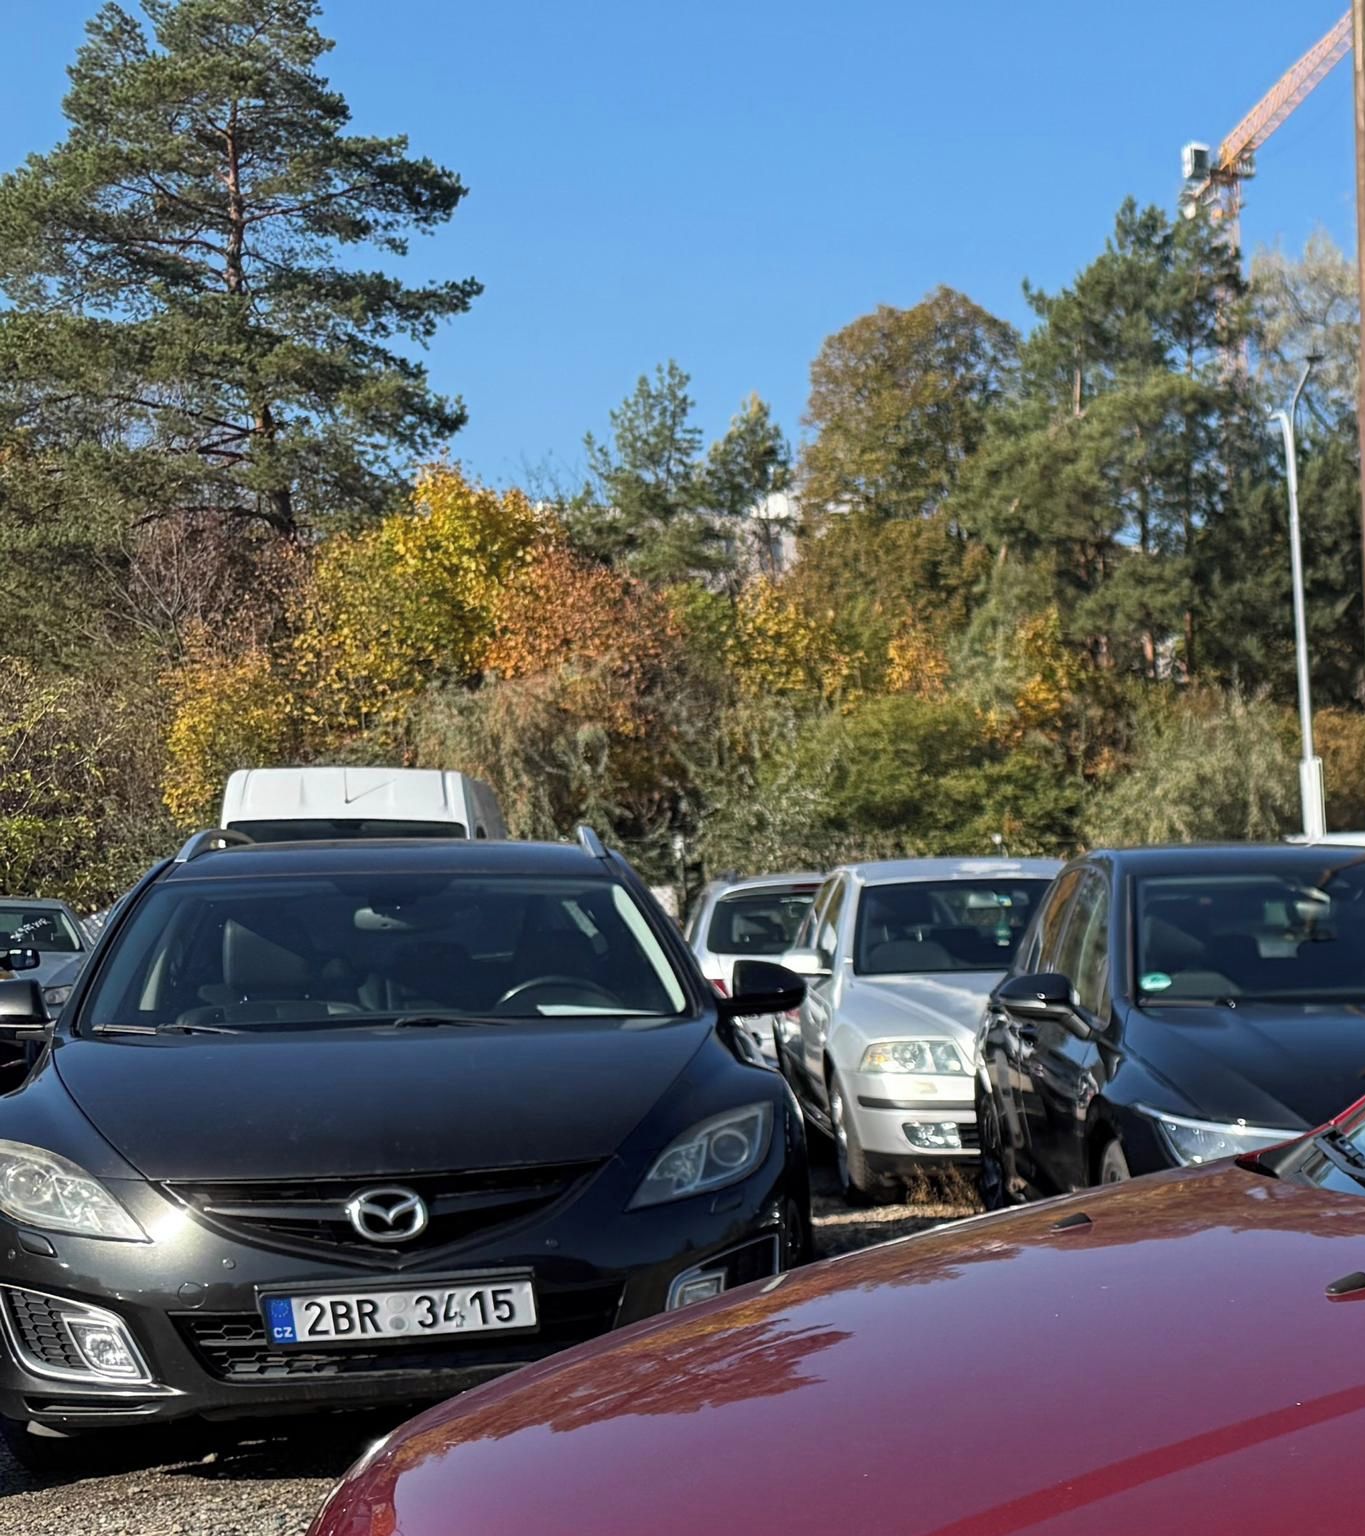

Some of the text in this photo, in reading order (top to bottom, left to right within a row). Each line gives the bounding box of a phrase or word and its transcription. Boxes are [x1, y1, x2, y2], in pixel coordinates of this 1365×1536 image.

[304, 1288, 516, 1337] 2BR 3415
[273, 1326, 294, 1338] CZ
